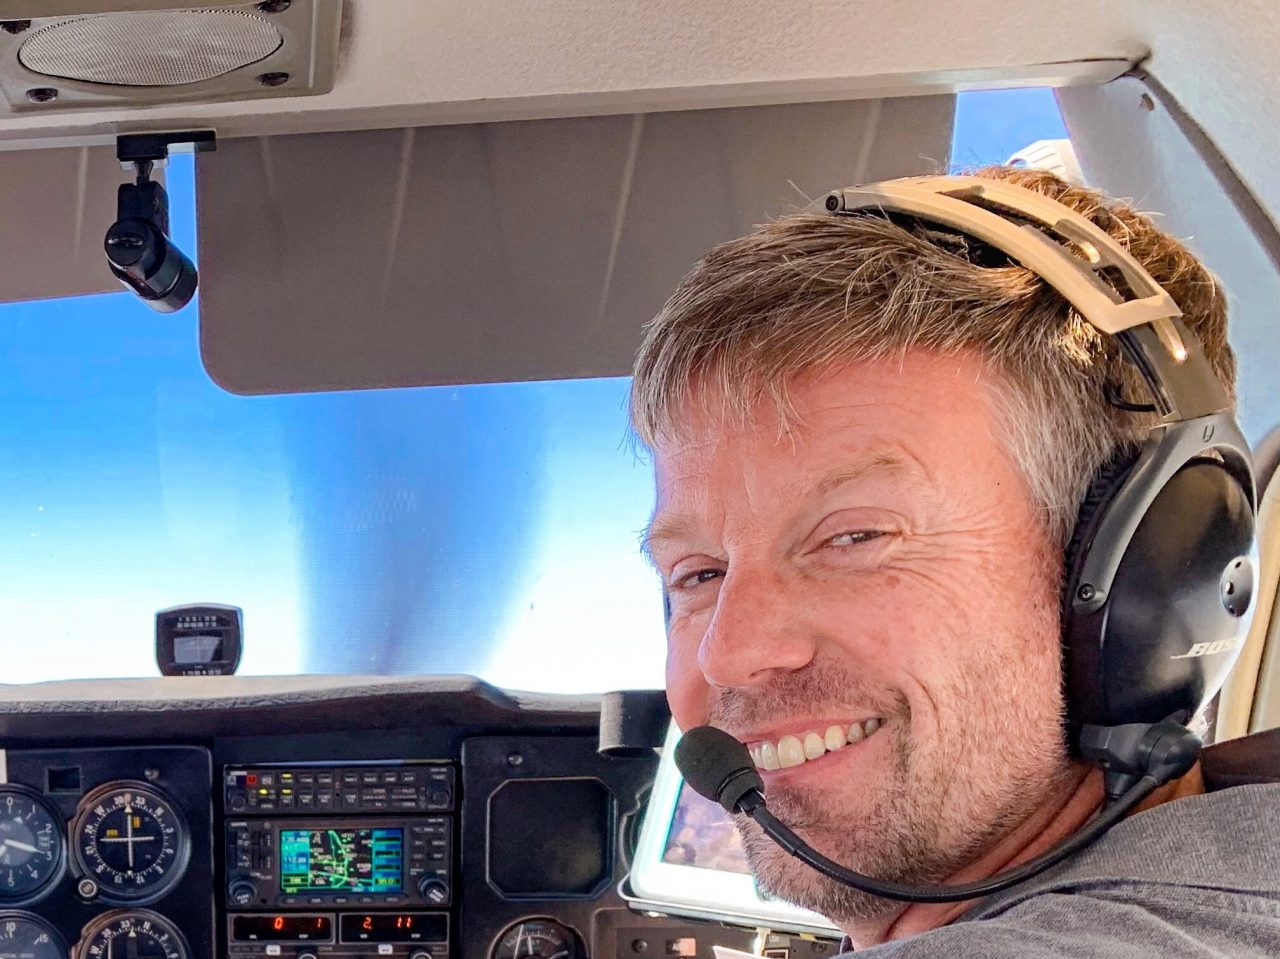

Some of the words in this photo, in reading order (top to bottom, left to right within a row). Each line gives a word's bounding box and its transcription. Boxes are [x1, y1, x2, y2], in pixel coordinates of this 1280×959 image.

[1170, 638, 1237, 659] BOS
[6, 797, 13, 806] 0
[45, 823, 52, 833] 2
[30, 870, 38, 879] 4
[8, 877, 15, 887] 5
[6, 922, 16, 931] 10
[274, 917, 283, 930] 0
[39, 934, 48, 943] 15
